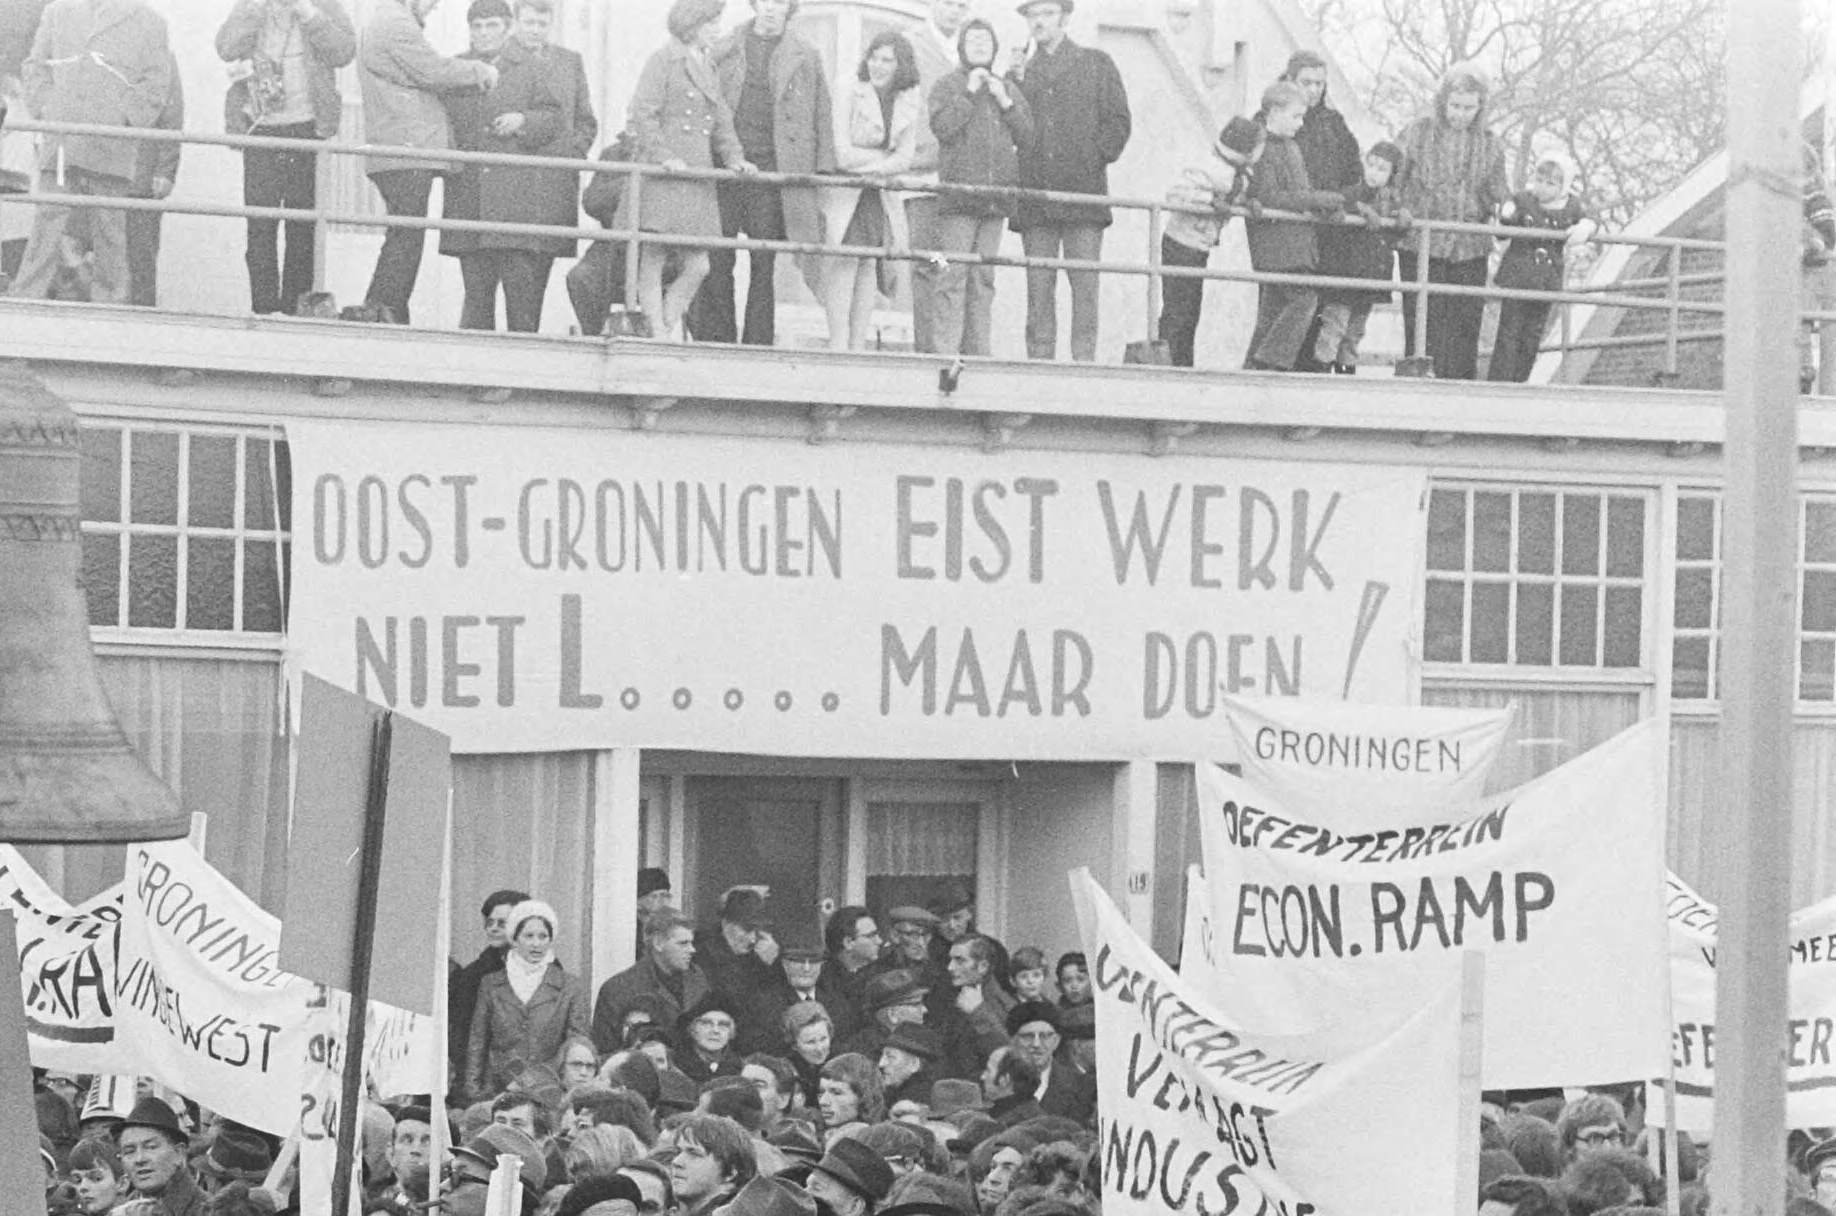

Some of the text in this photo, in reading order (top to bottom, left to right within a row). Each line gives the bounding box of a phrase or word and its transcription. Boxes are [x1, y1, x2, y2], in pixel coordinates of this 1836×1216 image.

[313, 473, 1342, 592] OOST-GRONINGEN EIST WERK
[355, 615, 526, 708] NIET
[880, 622, 1096, 719] MAAR
[1255, 727, 1461, 773] GRONINGEN
